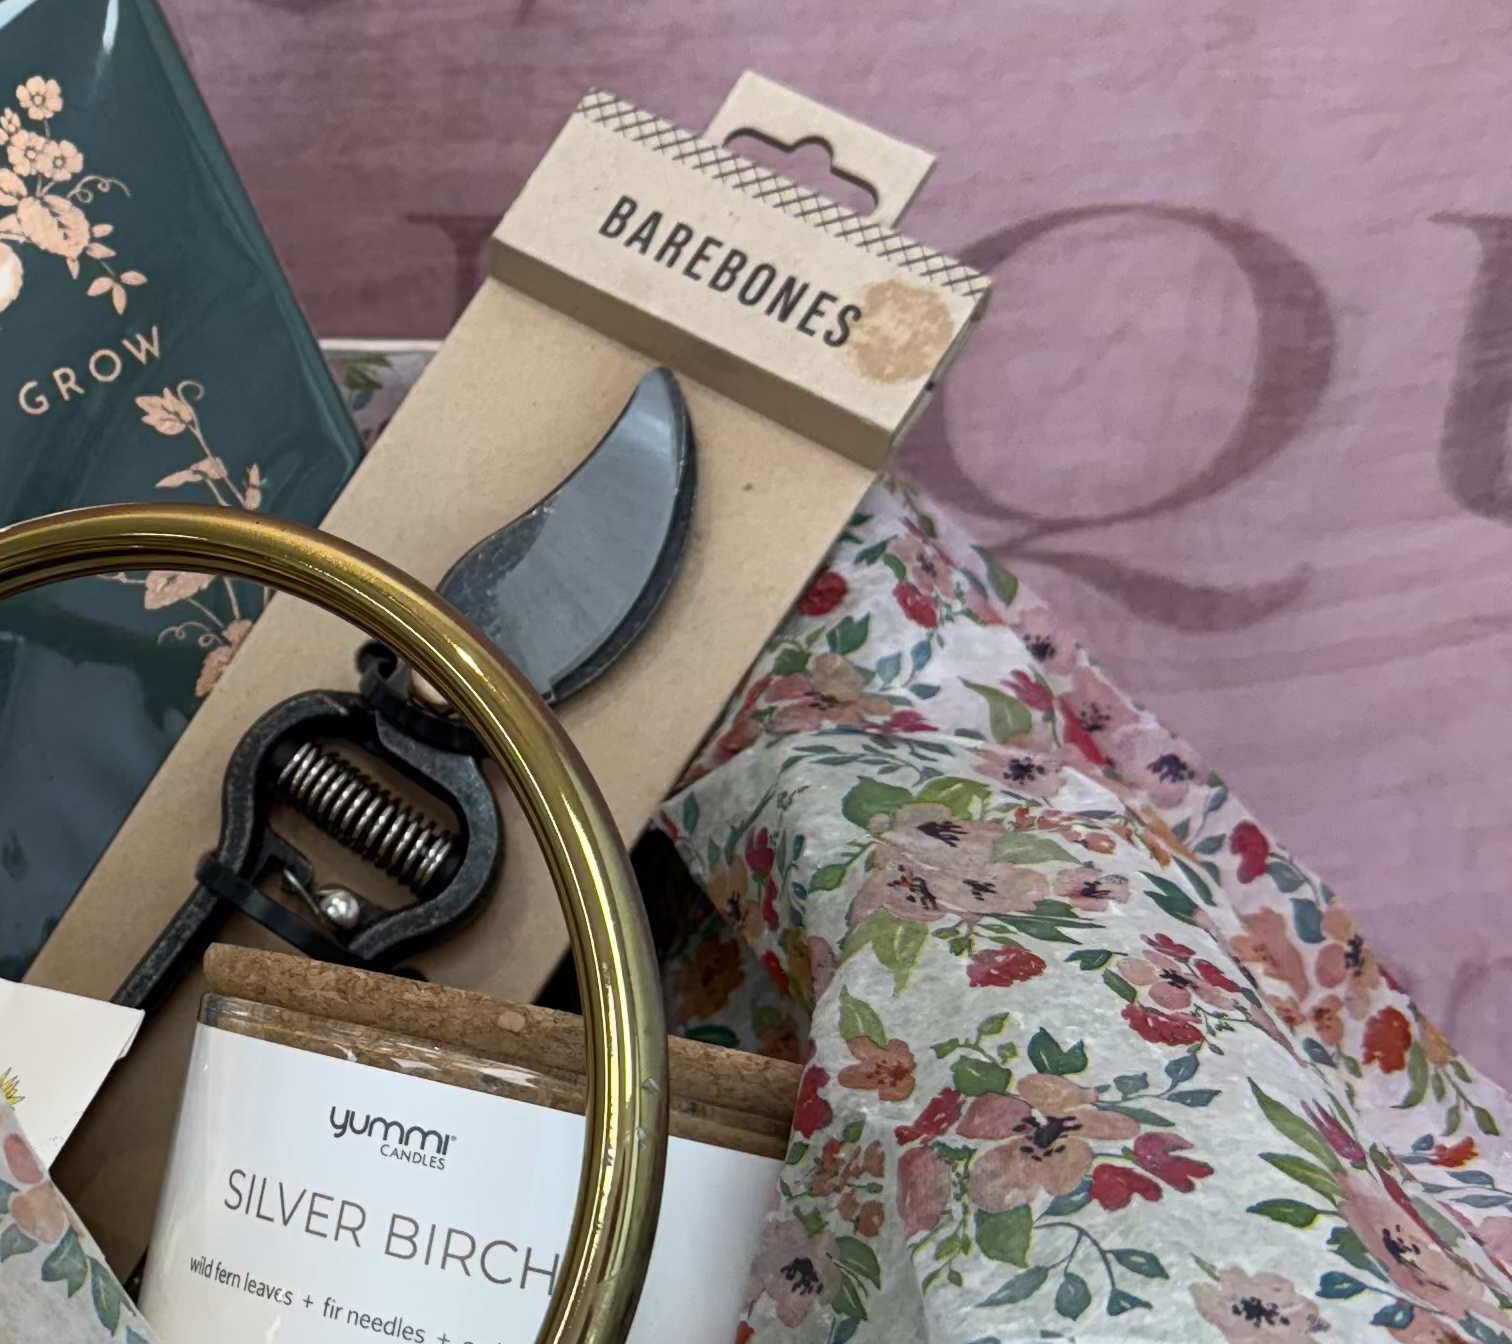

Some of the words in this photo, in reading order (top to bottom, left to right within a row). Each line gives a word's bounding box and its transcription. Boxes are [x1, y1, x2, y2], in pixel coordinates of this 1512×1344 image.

[598, 195, 863, 348] BAREBONES
[18, 325, 160, 415] GROW
[379, 1144, 446, 1171] CANDLES
[224, 1168, 367, 1248] SILVER
[384, 1213, 561, 1296] BIRCH
[189, 1255, 213, 1279] wild
[214, 1260, 241, 1288] fern
[243, 1272, 294, 1307] leaves
[322, 1297, 344, 1321] fir
[346, 1308, 427, 1344] needles
